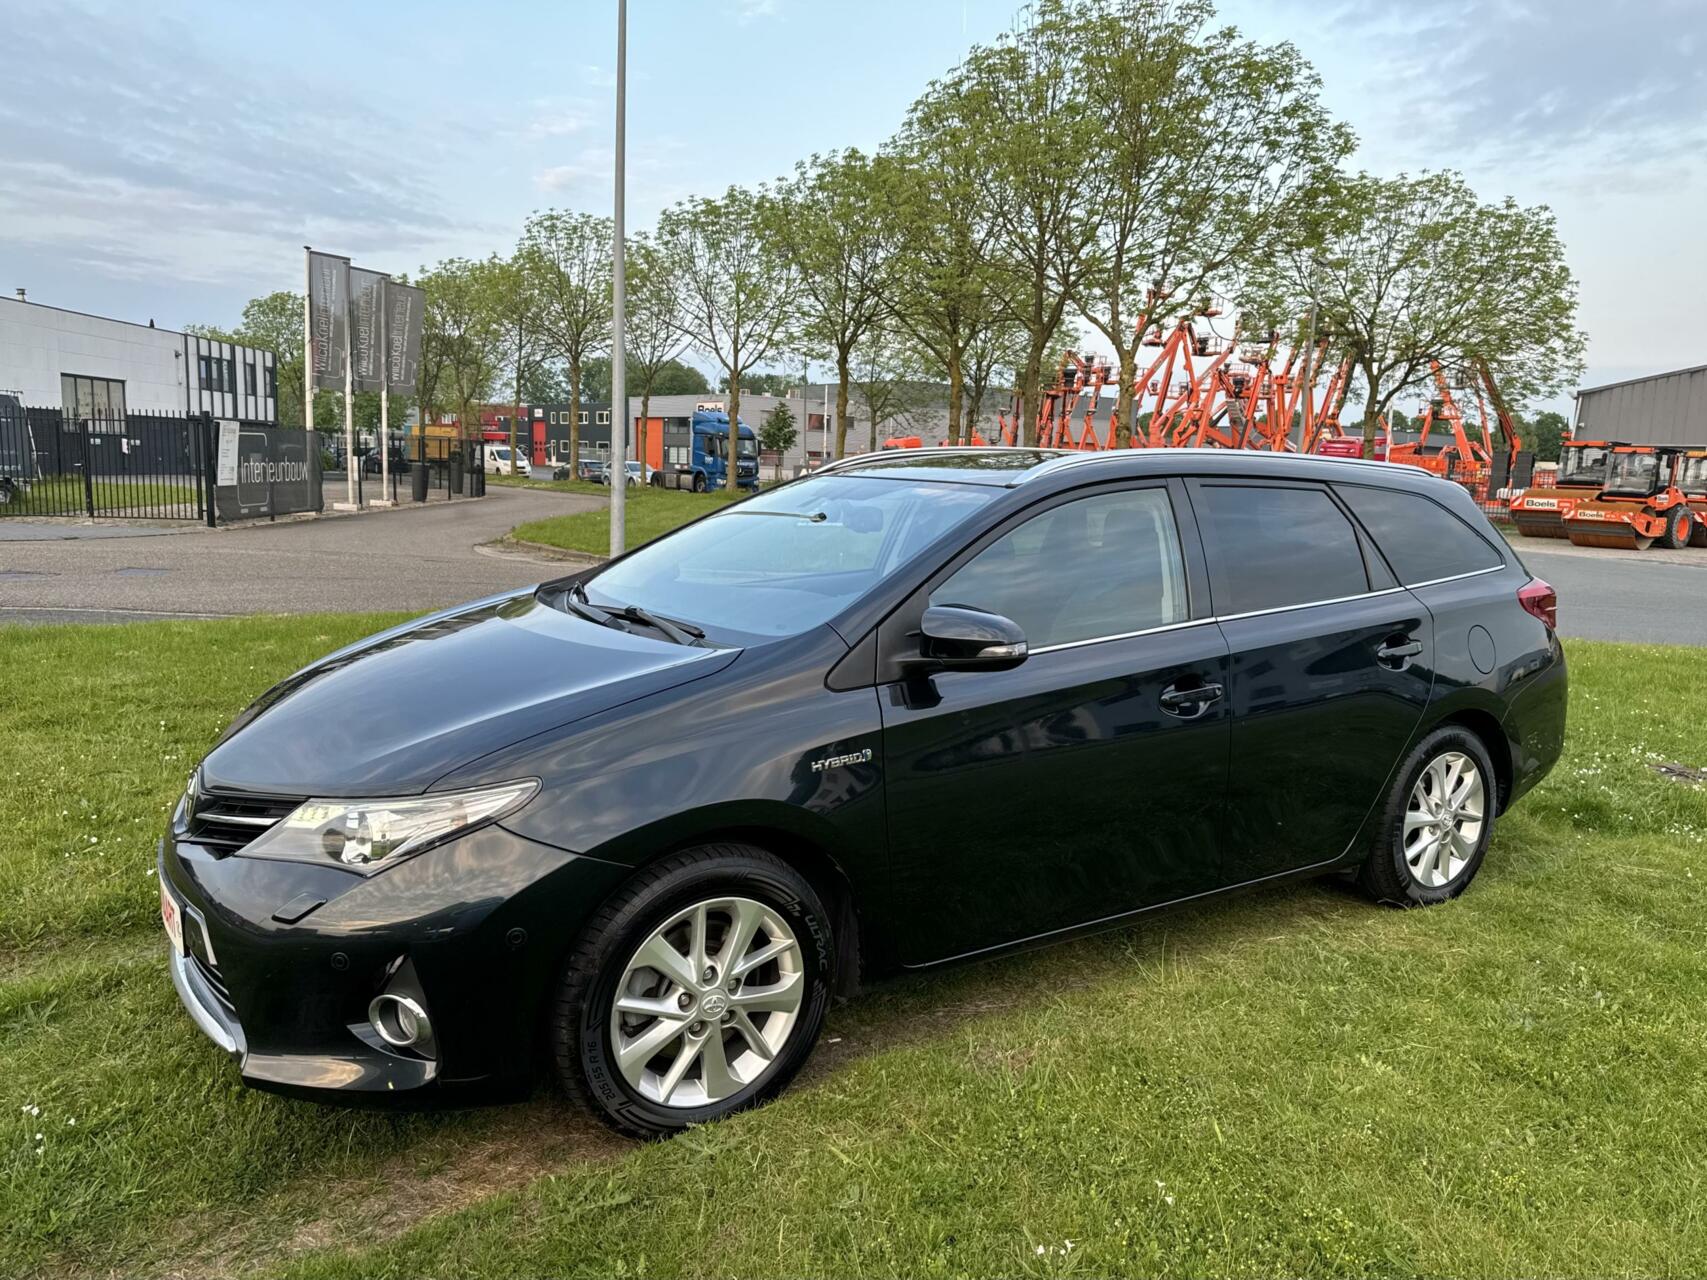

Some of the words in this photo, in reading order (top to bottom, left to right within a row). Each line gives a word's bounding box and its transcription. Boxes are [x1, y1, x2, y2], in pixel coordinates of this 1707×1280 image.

[241, 456, 308, 483] Interieurbouw
[1526, 499, 1556, 508] Boels
[811, 752, 863, 772] HYBRID
[804, 915, 828, 971] ULTRAC
